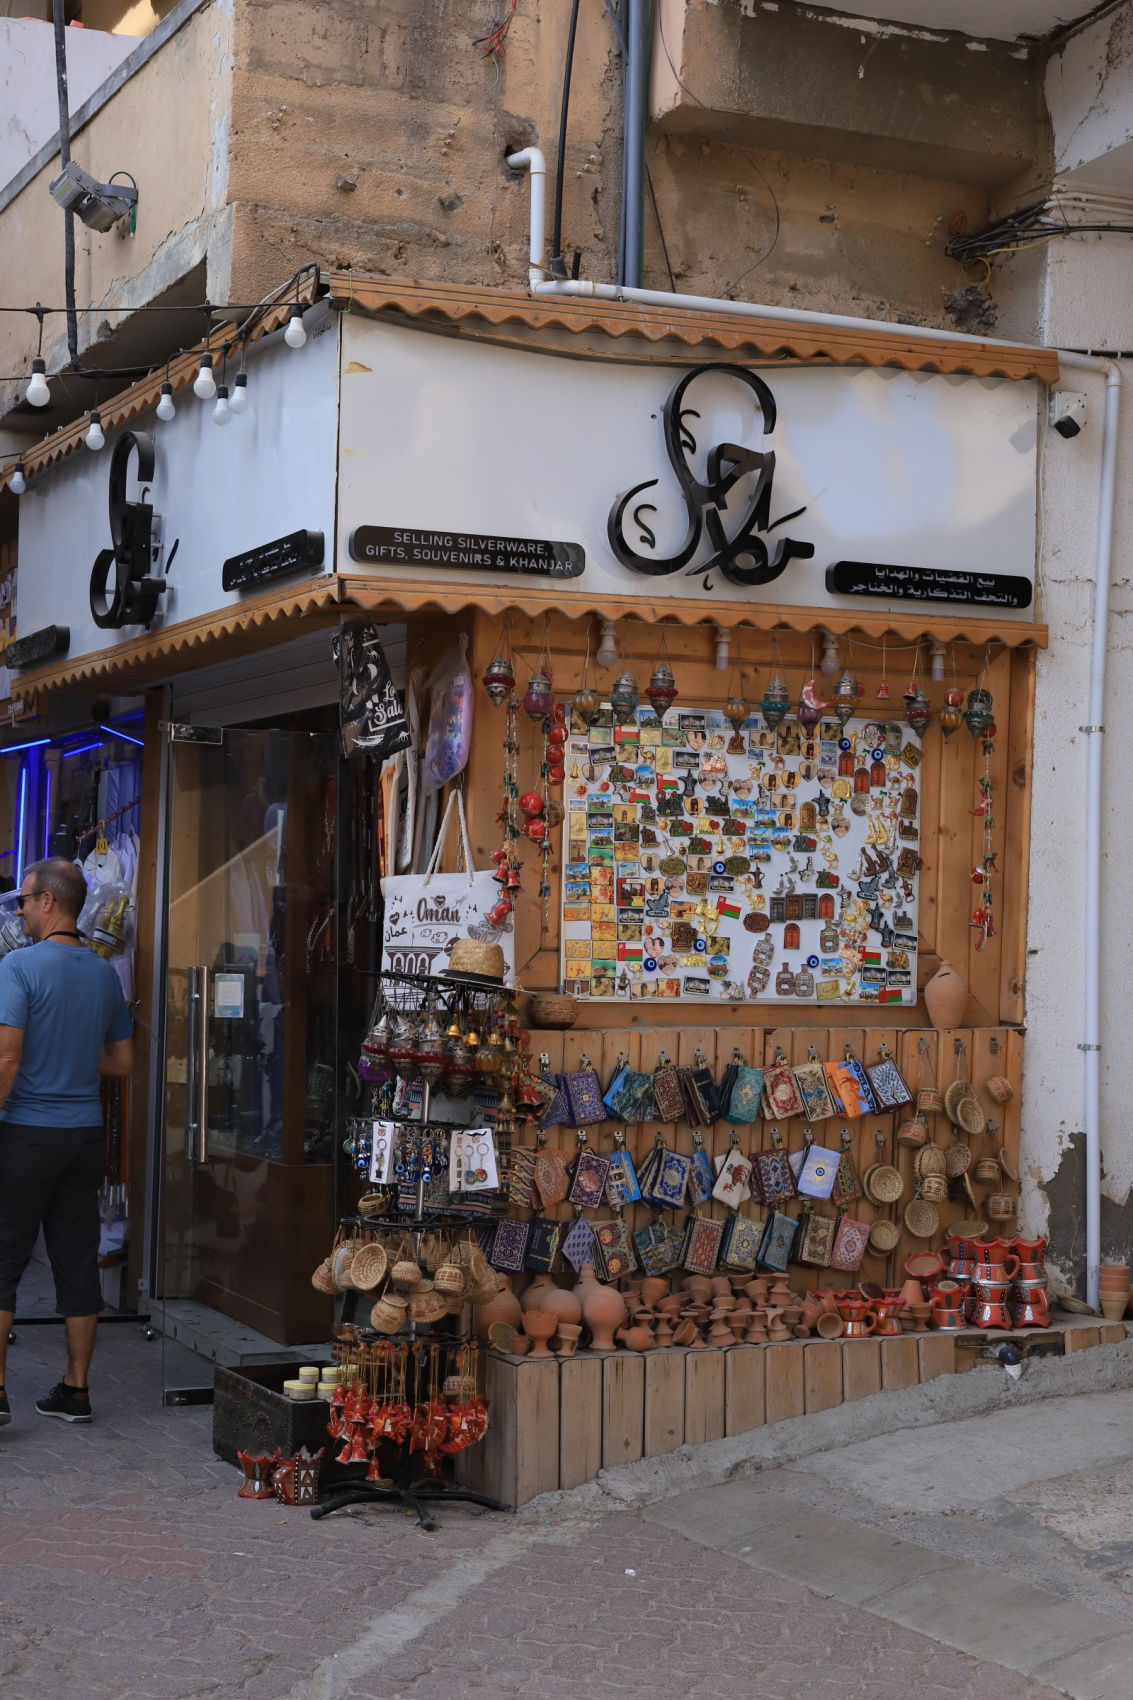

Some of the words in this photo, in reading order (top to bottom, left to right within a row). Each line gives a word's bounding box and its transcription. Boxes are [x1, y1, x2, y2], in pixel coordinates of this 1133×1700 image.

[393, 532, 453, 548] SELLING
[457, 537, 548, 556] SILVERWARE,
[365, 545, 408, 560] GIFTS,
[412, 548, 492, 566] SOUVENIRS
[496, 556, 505, 567] &
[509, 556, 574, 572] KHANJAR
[874, 566, 920, 582] والهدايا
[922, 569, 974, 584] الفضيات
[849, 580, 904, 596] والخناجر
[976, 577, 996, 588] بيع
[906, 584, 972, 600] التذكارية
[973, 590, 1018, 606] والتحف
[416, 897, 461, 923] Oman
[384, 926, 408, 943] عمان
